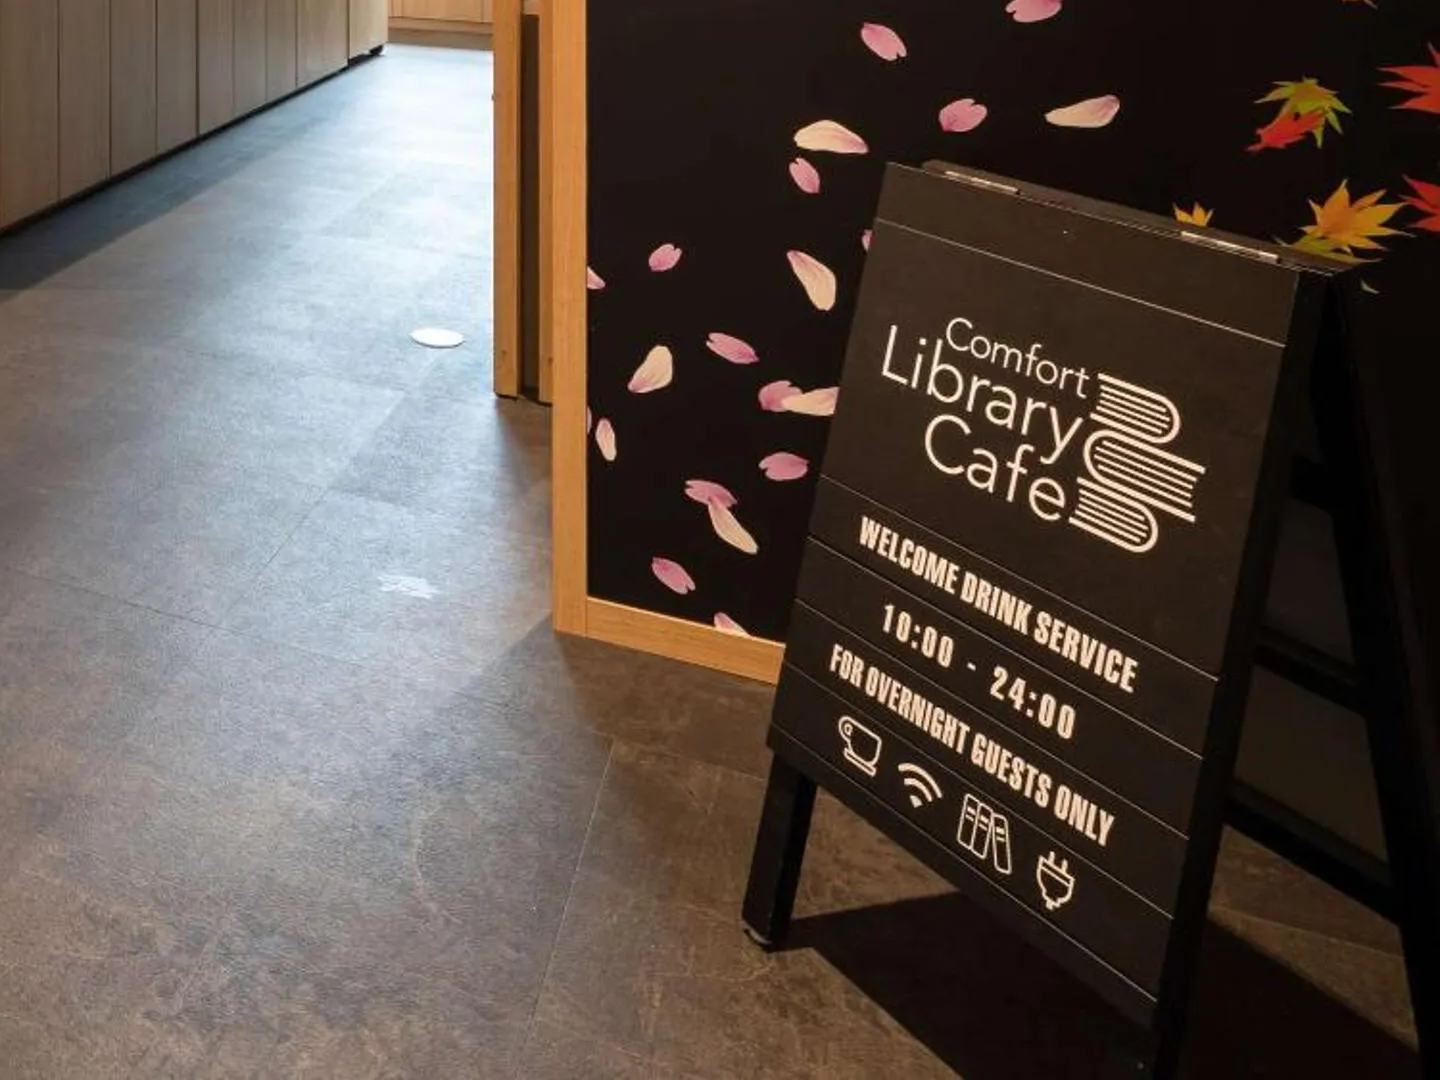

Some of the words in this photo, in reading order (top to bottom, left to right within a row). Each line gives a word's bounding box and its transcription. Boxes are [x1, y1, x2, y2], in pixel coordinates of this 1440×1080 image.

[882, 325, 1084, 465] Library
[946, 317, 1090, 398] Comfort
[925, 414, 1066, 522] Cafe
[860, 516, 960, 594] WELCOME
[960, 572, 1033, 636] DRINK
[1034, 611, 1139, 693] SERVICE
[883, 605, 954, 668] 10:00
[990, 666, 1076, 740] 24:00
[830, 644, 864, 688] FOR
[865, 667, 971, 754] OVERNIGHT
[971, 733, 1053, 808] GUESTS
[1054, 785, 1115, 846] ONLY
